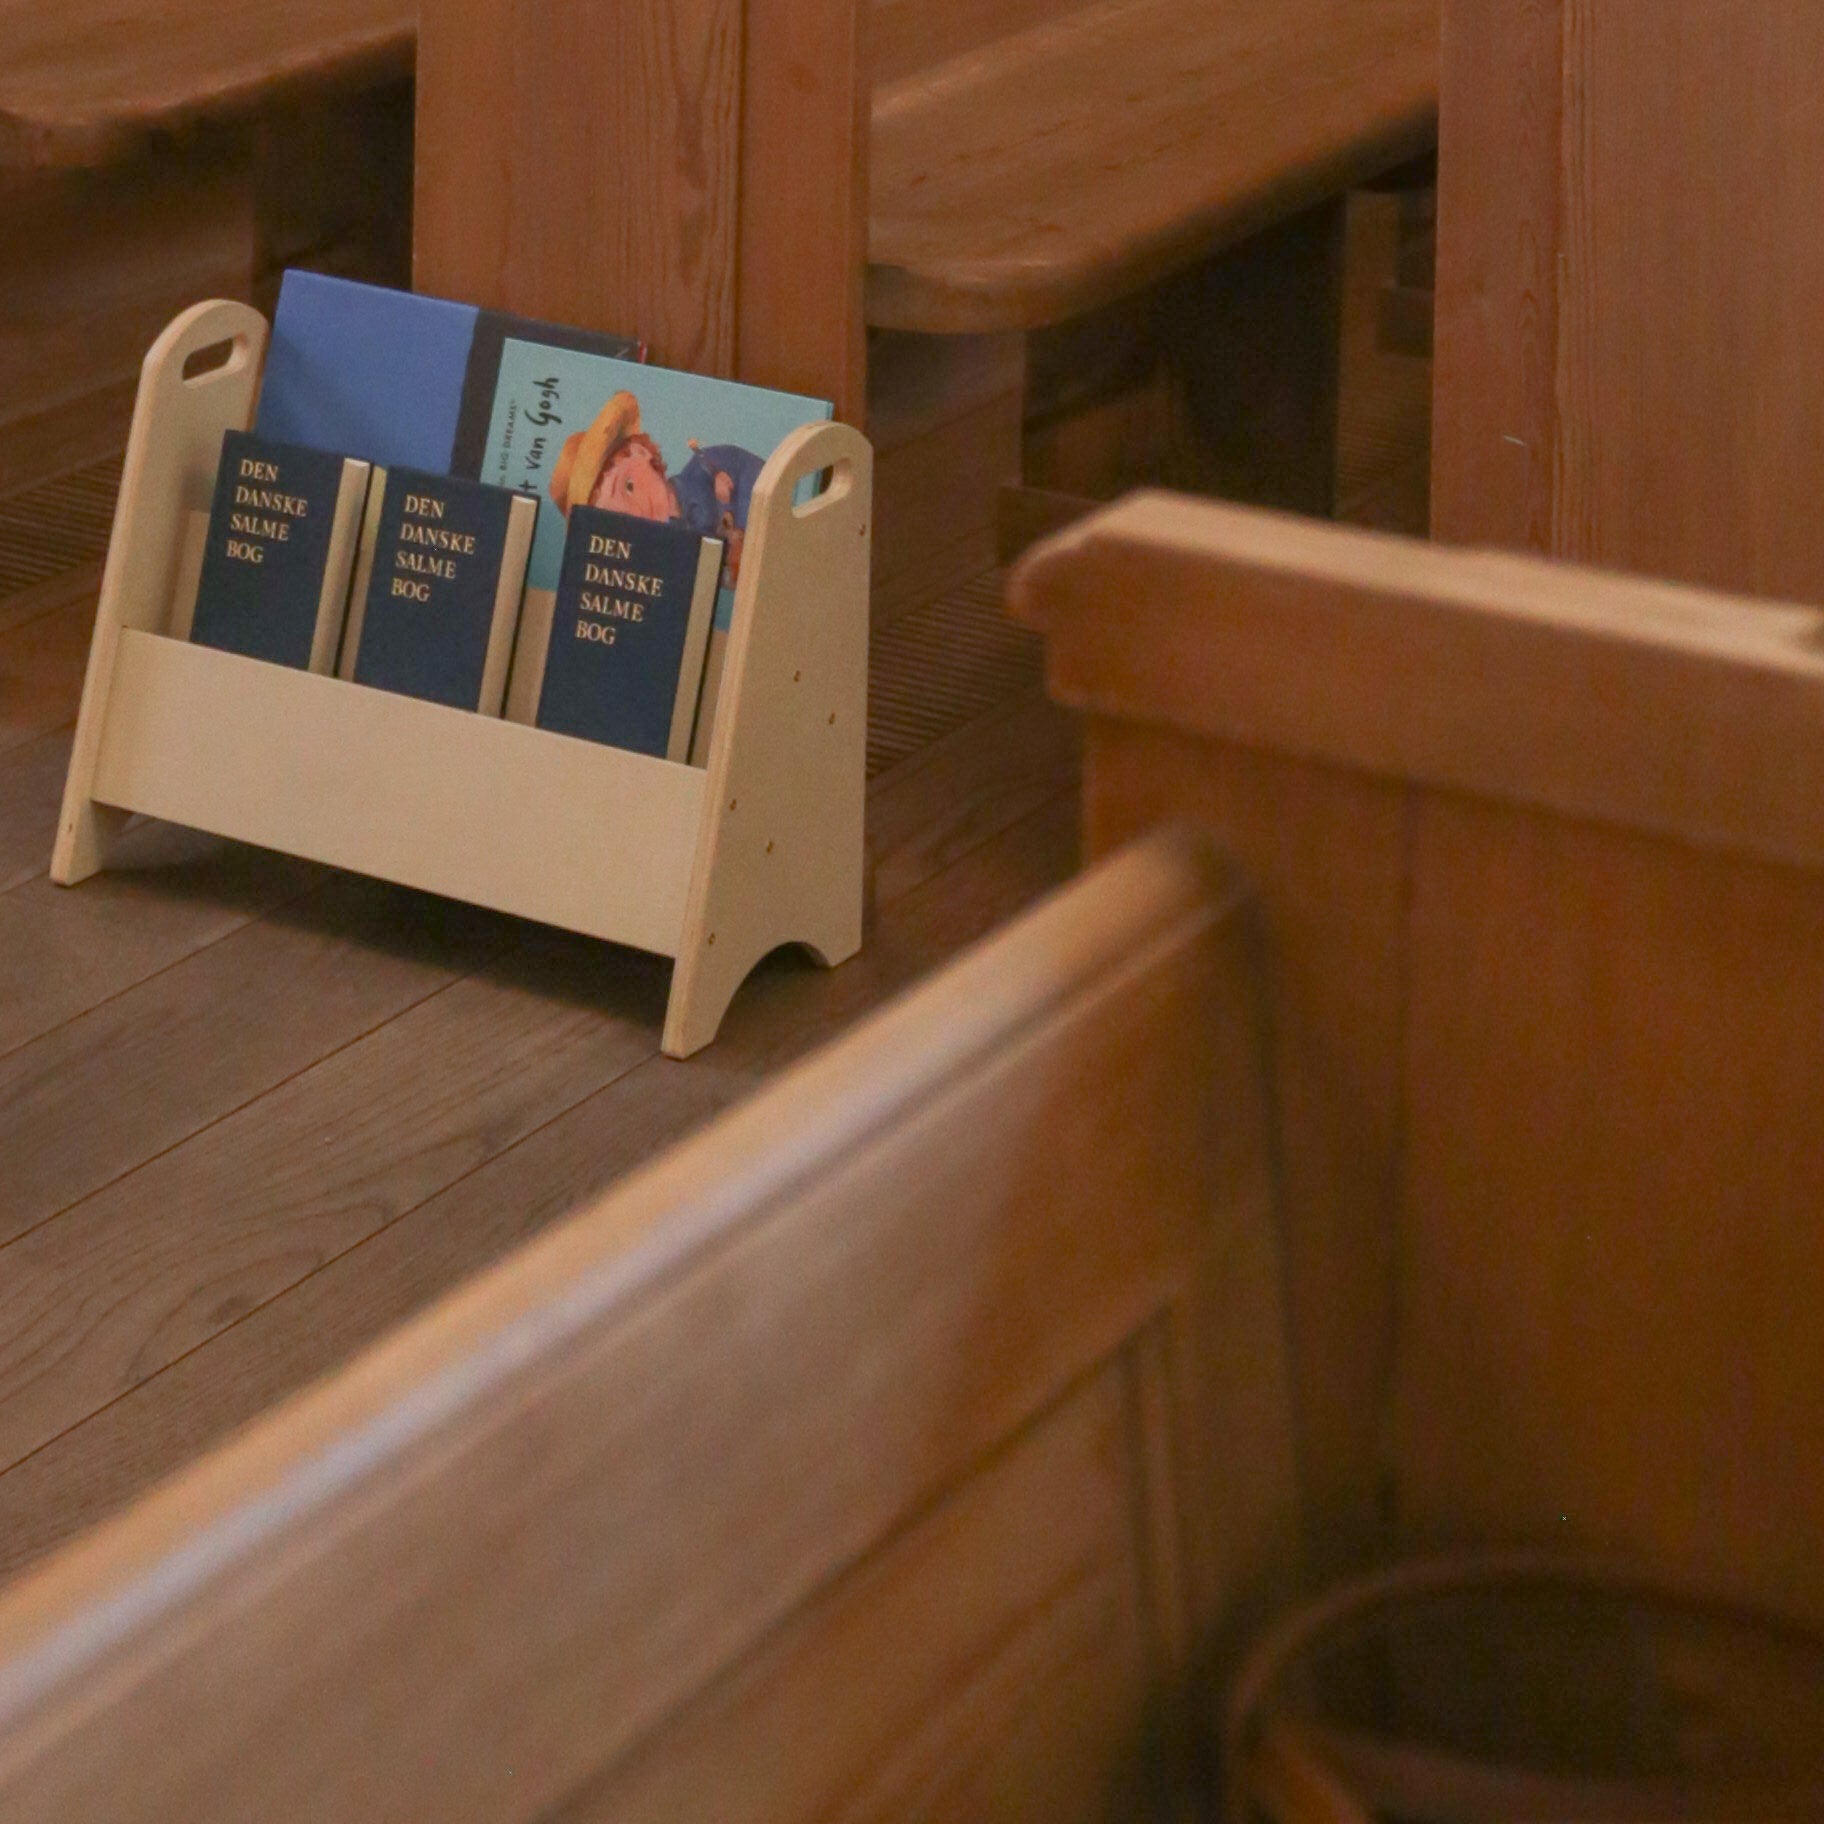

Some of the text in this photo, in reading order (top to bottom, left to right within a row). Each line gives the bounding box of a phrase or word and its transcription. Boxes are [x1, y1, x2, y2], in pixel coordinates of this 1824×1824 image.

[524, 376, 562, 425] Gogh
[525, 437, 546, 469] van
[240, 459, 278, 482] DEN
[235, 485, 308, 517] DANSKE
[404, 494, 445, 518] DEN
[229, 513, 289, 541] SALME
[399, 523, 475, 555] DANSKE
[225, 539, 264, 564] BOG
[589, 535, 632, 559] DEN
[395, 550, 456, 579] SALME
[391, 577, 431, 602] BOG
[584, 563, 664, 597] DANSKE
[579, 591, 644, 622] SALME
[575, 619, 616, 645] BOG
